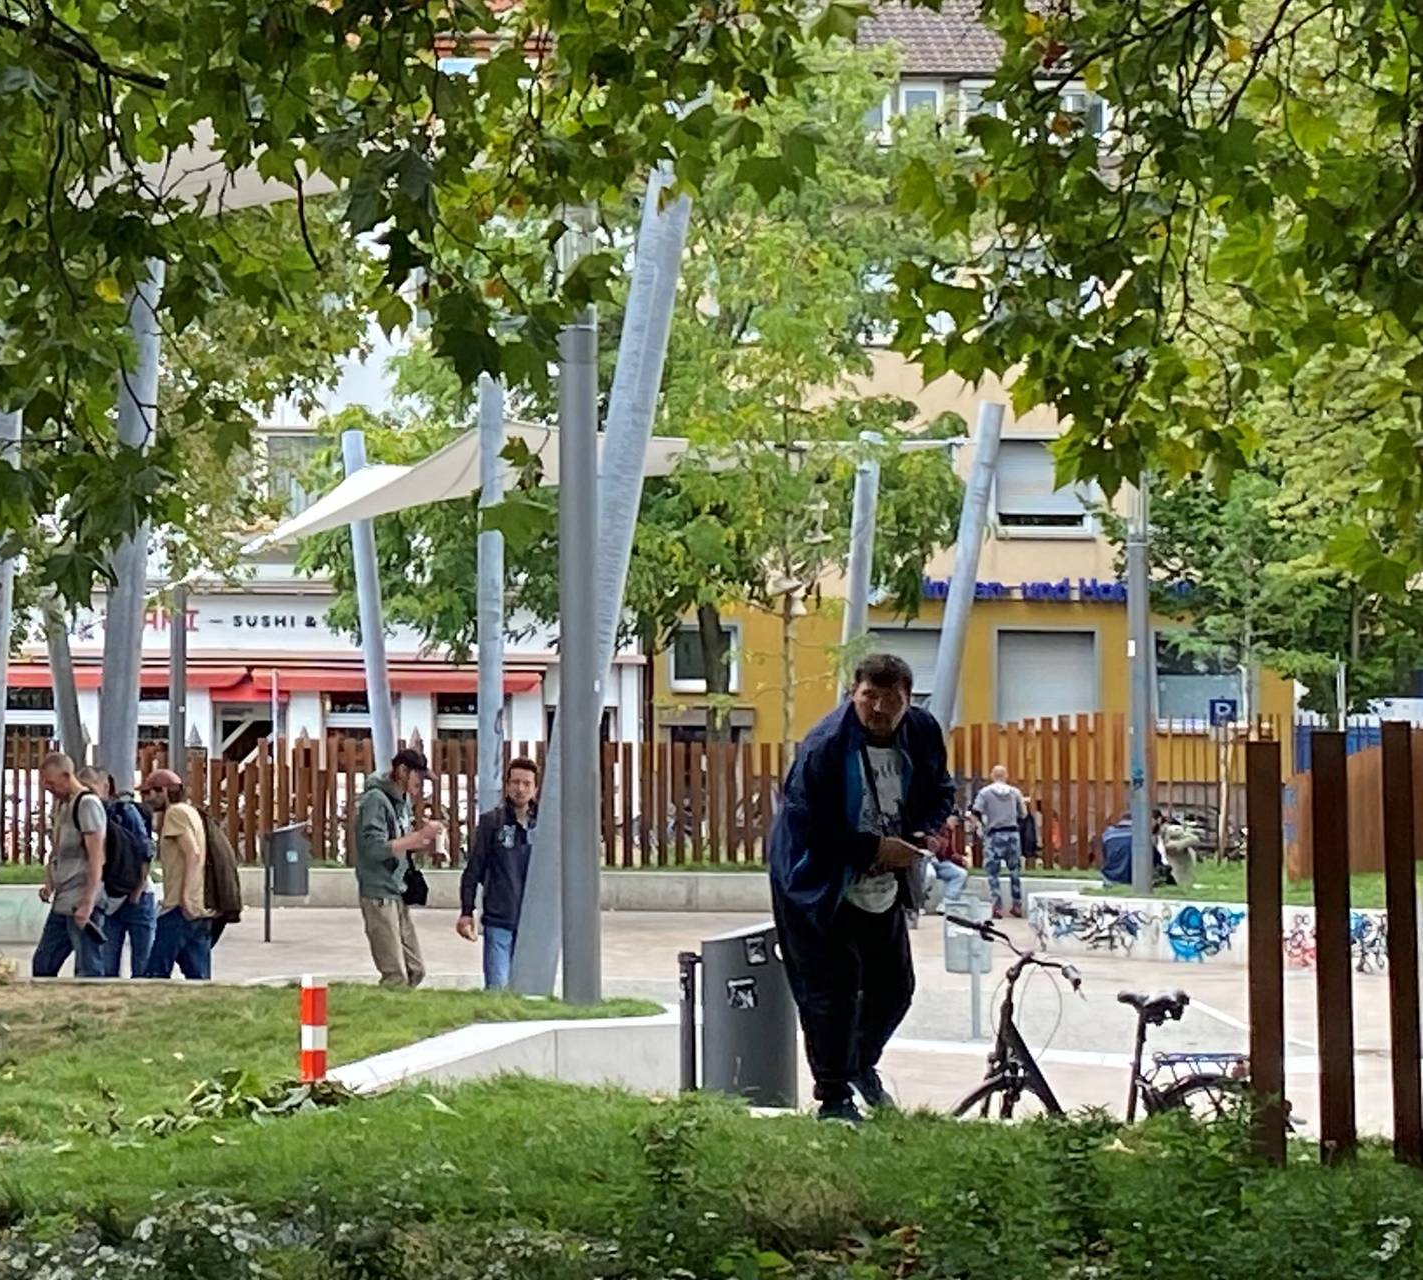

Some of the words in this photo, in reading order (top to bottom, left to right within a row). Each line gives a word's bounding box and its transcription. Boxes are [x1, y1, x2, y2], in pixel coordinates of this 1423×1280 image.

[233, 615, 296, 629] SUSHI
[305, 615, 316, 628] &
[1214, 702, 1232, 724] P
